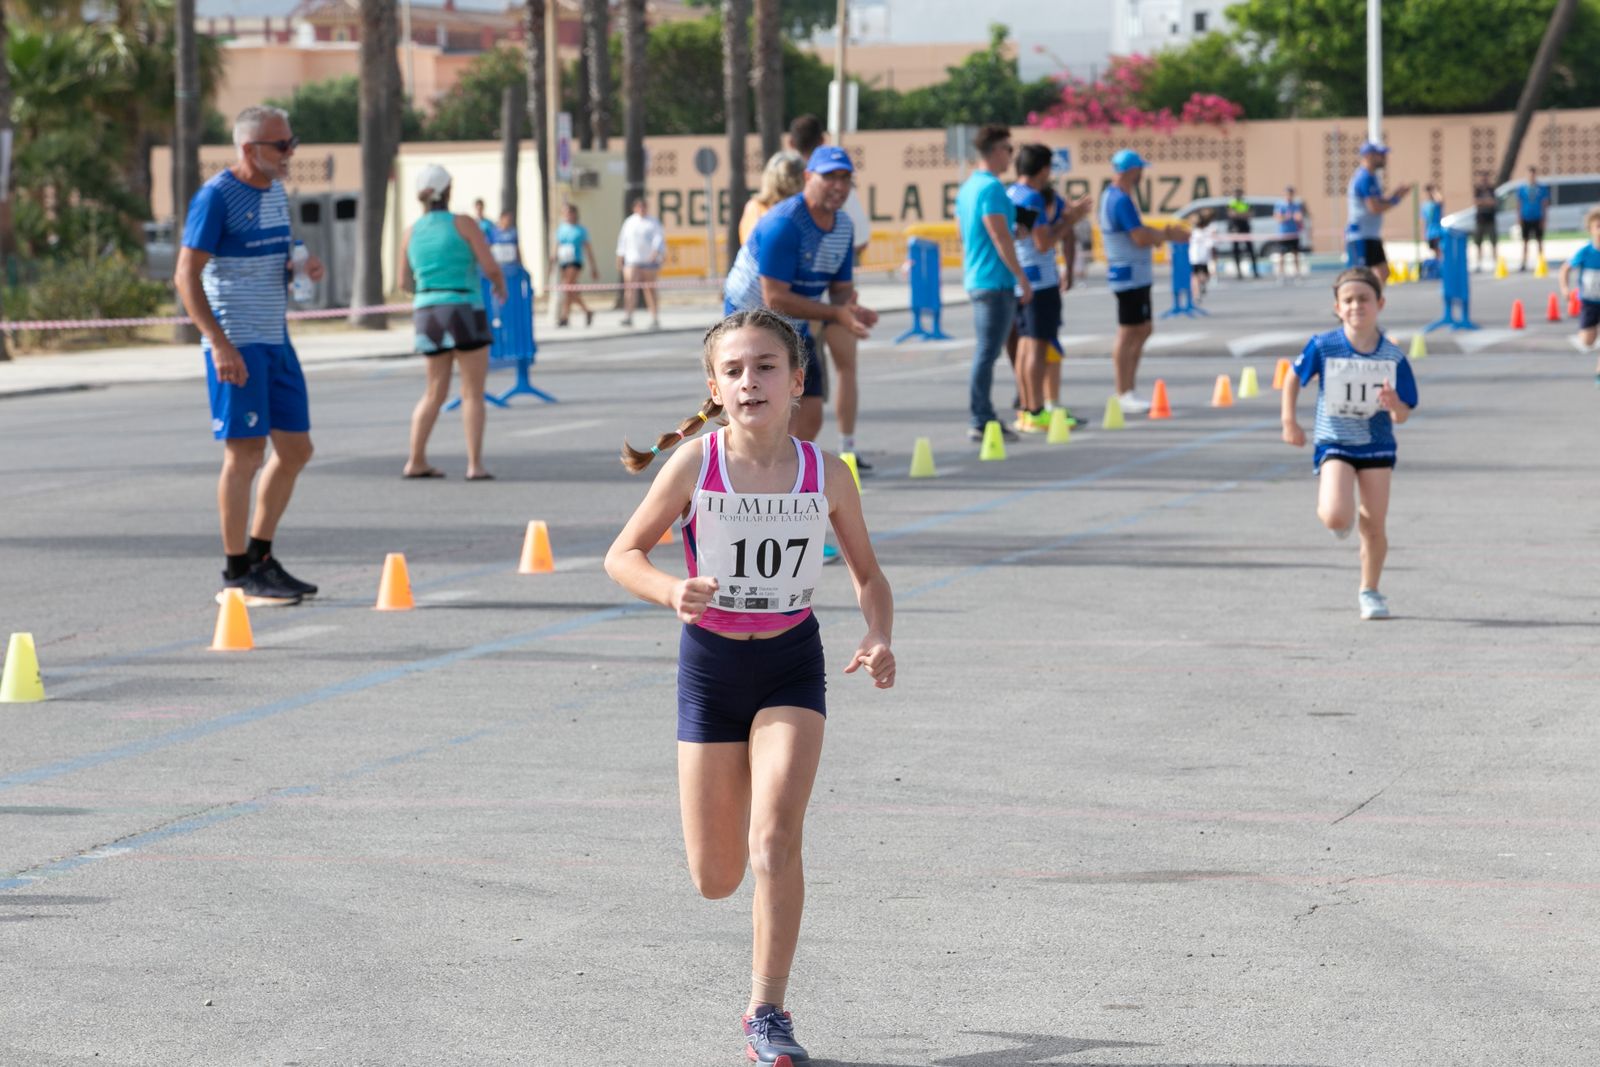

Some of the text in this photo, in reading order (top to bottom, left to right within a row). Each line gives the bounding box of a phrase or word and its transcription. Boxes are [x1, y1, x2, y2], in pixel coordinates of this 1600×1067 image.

[868, 184, 924, 221] LA
[706, 496, 820, 515] II MILLA
[719, 514, 763, 523] POPULAR
[729, 538, 809, 578] 107
